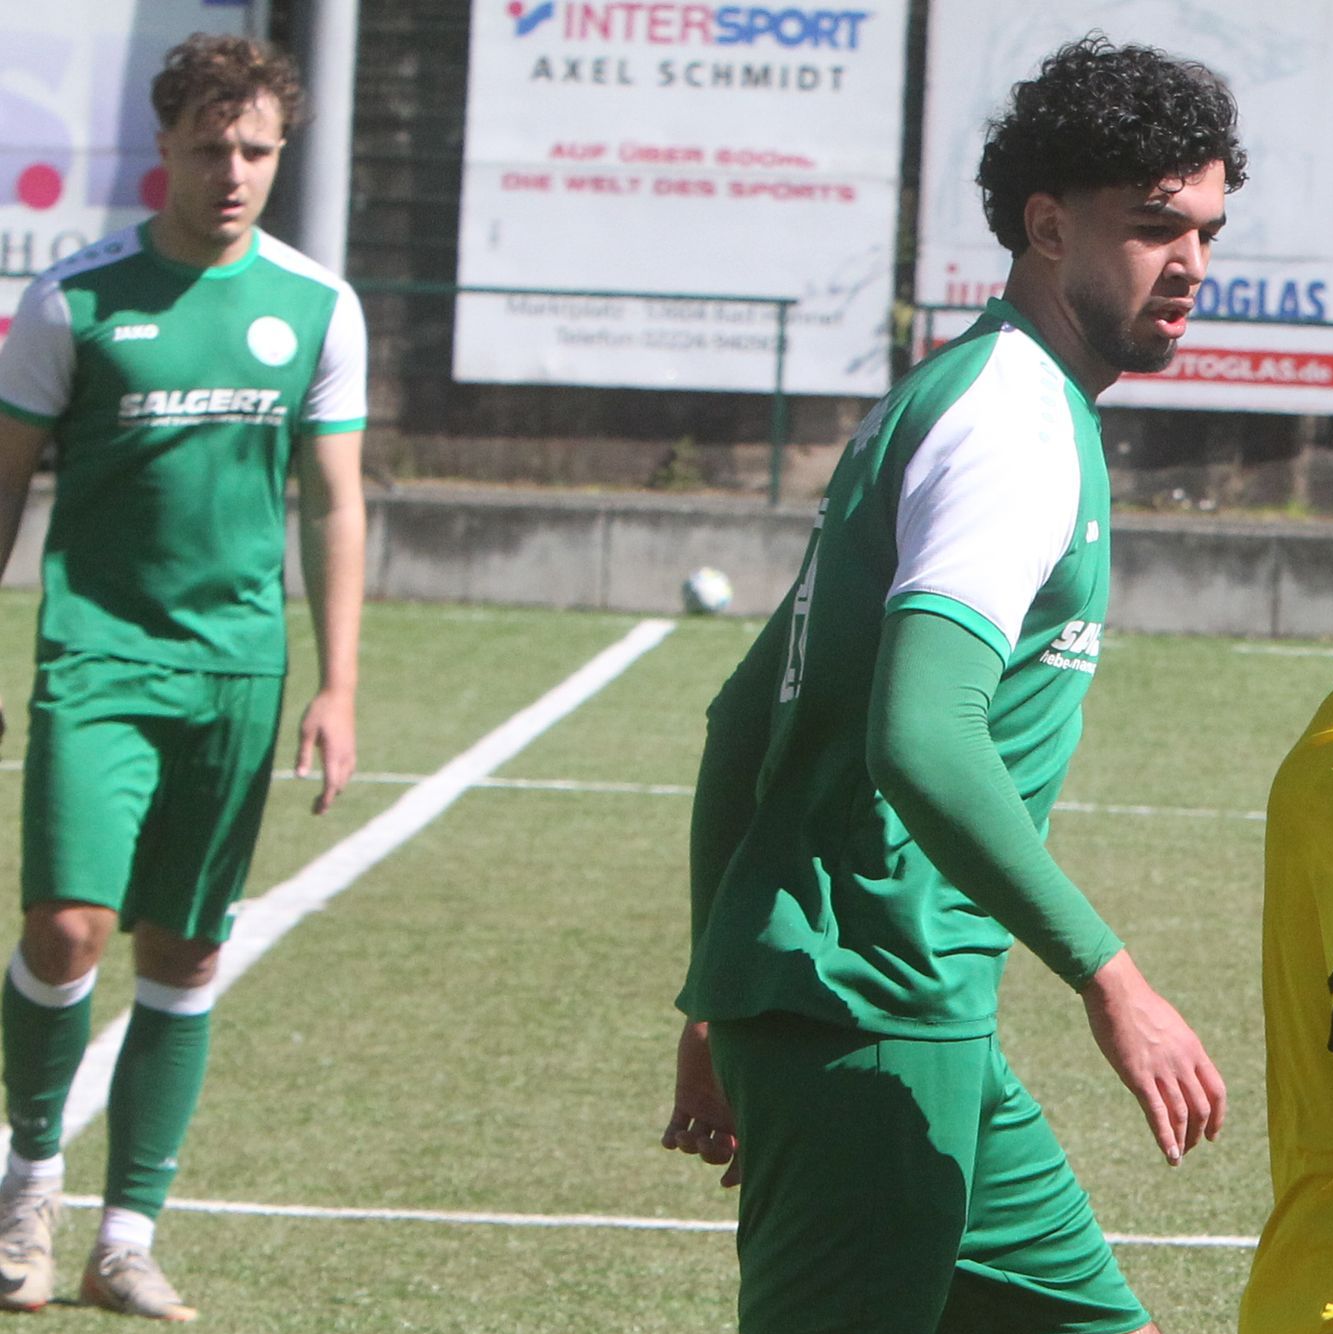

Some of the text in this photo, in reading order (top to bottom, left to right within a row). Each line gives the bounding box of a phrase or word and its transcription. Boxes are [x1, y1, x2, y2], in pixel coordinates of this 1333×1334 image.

[564, 1, 869, 49] INTERSPORT
[531, 56, 848, 92] AXEL SCHMIDT
[500, 172, 857, 205] DIE WELT DES SPORTS
[1196, 277, 1327, 322] OGLAS
[119, 387, 281, 418] SALGERT
